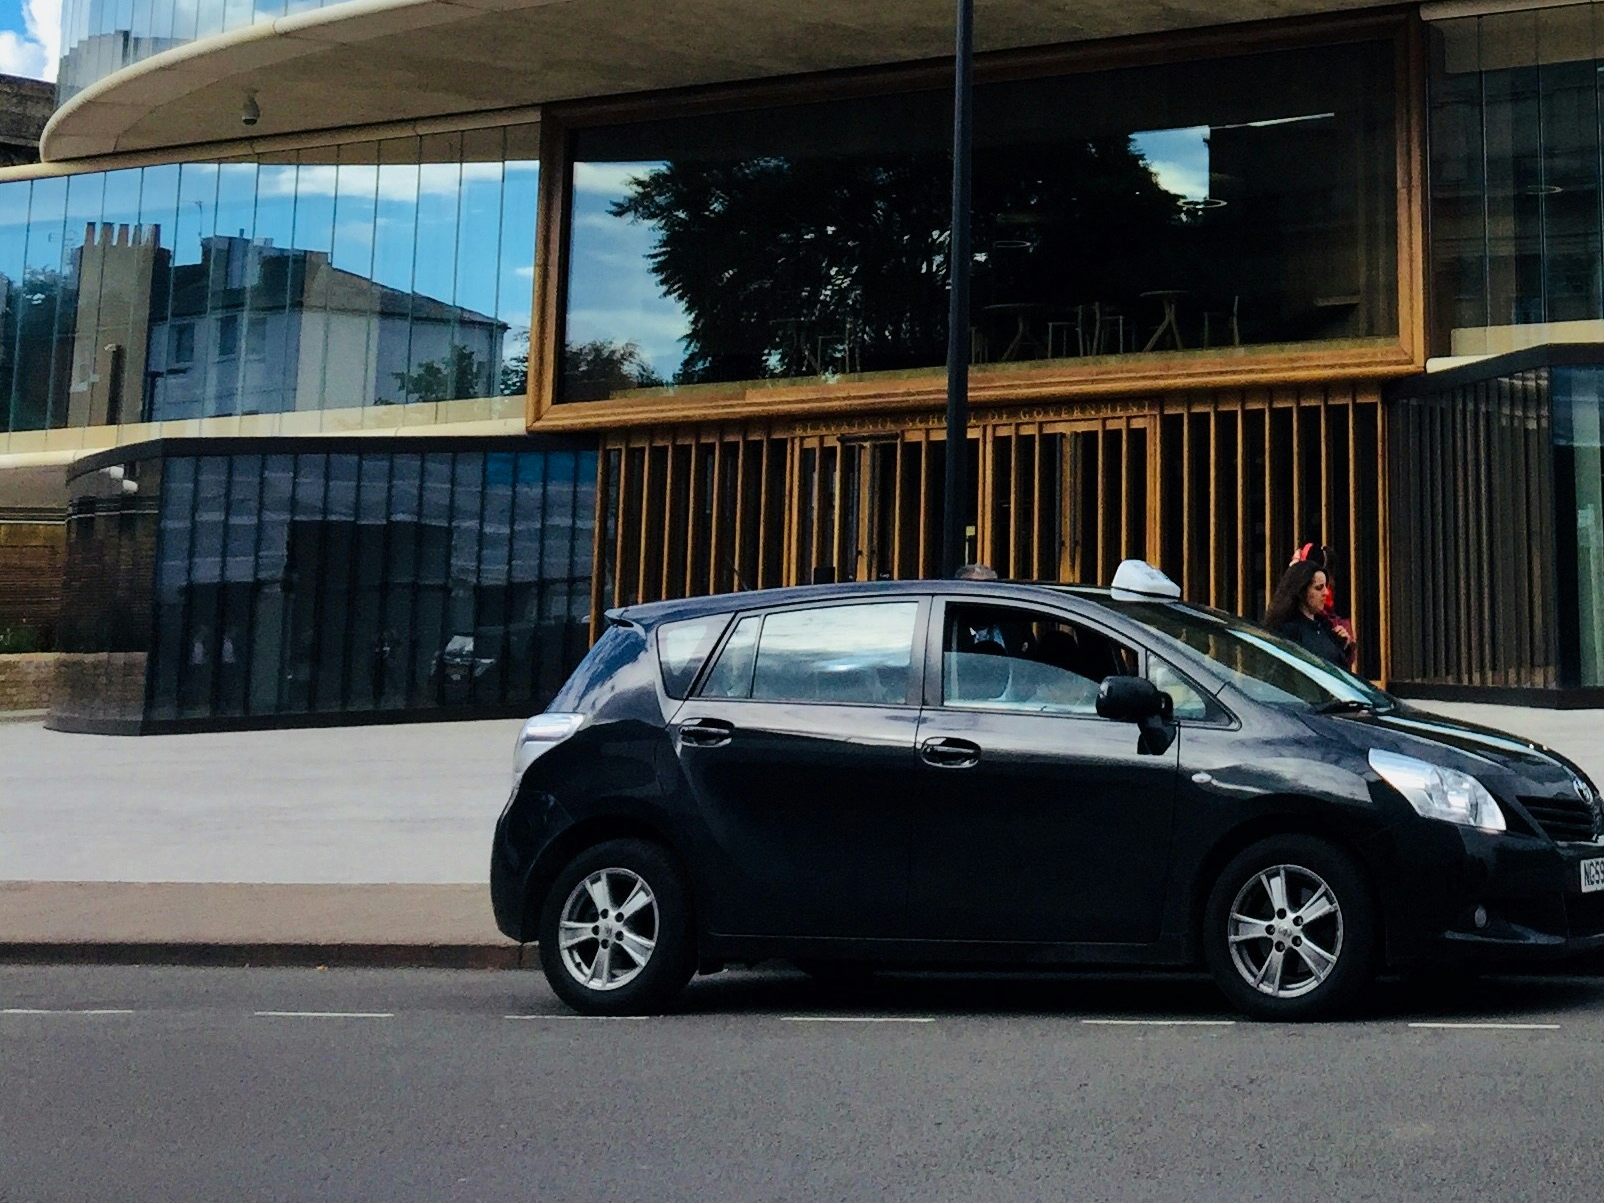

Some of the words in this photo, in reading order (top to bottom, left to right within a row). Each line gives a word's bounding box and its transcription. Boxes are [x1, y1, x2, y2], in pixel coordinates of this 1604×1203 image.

[796, 418, 895, 433] BLAVATNIK
[905, 411, 978, 426] SCHOL
[1020, 400, 1150, 421] GOVERNMENT
